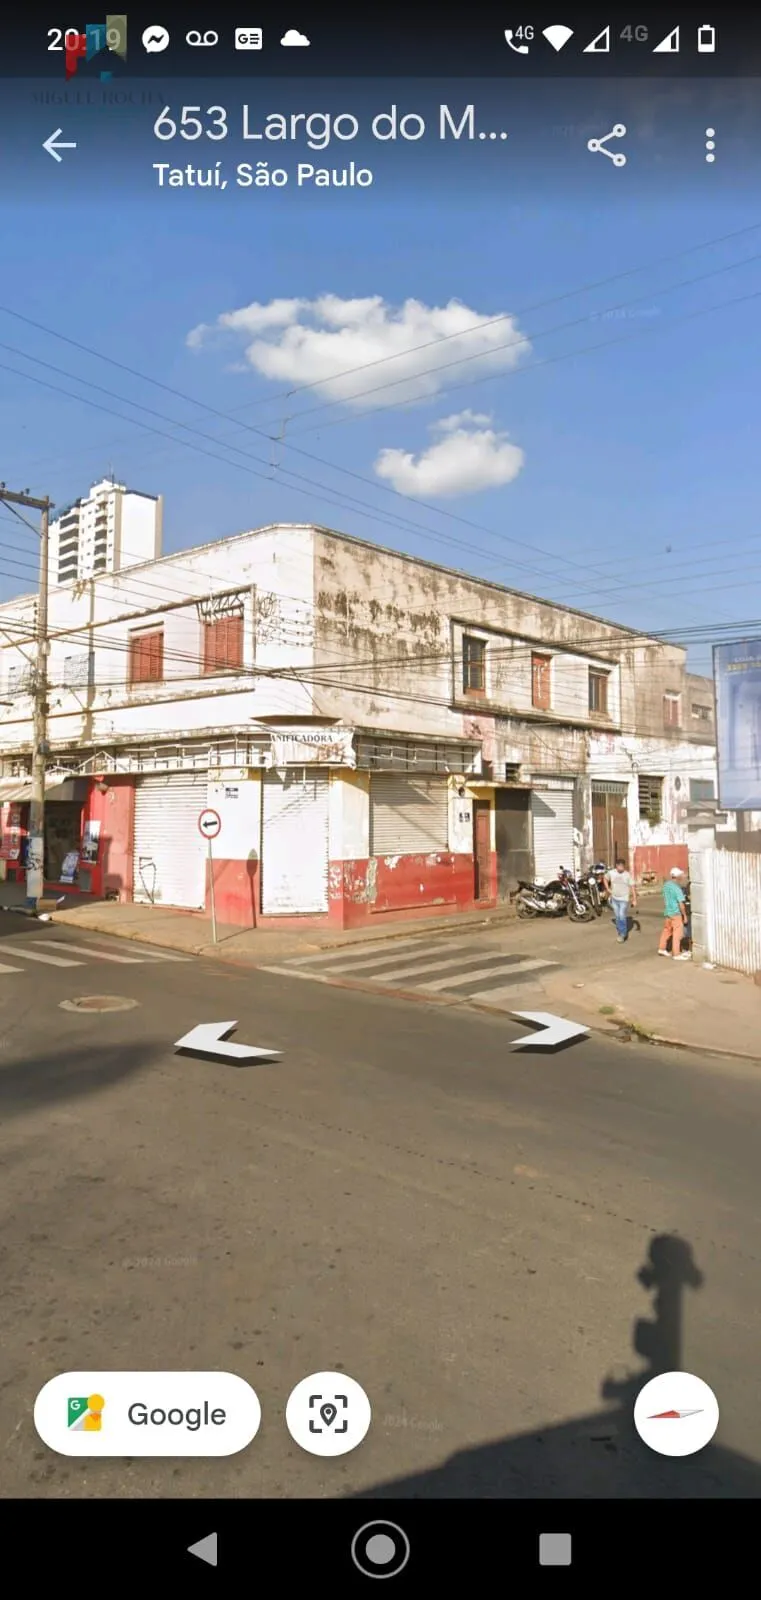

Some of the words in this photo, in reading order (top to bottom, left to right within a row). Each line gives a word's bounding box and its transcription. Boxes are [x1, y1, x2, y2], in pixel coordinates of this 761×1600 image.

[47, 28, 121, 51] 20:19
[515, 26, 535, 40] 4G
[620, 25, 649, 42] 4G
[152, 105, 229, 141] 653
[242, 104, 359, 151] Largo
[371, 104, 426, 141] do
[439, 104, 508, 141] M...
[152, 161, 228, 191] Tatuí,
[236, 161, 288, 188] São
[298, 161, 374, 188] Paulo
[128, 1401, 227, 1432] Google
